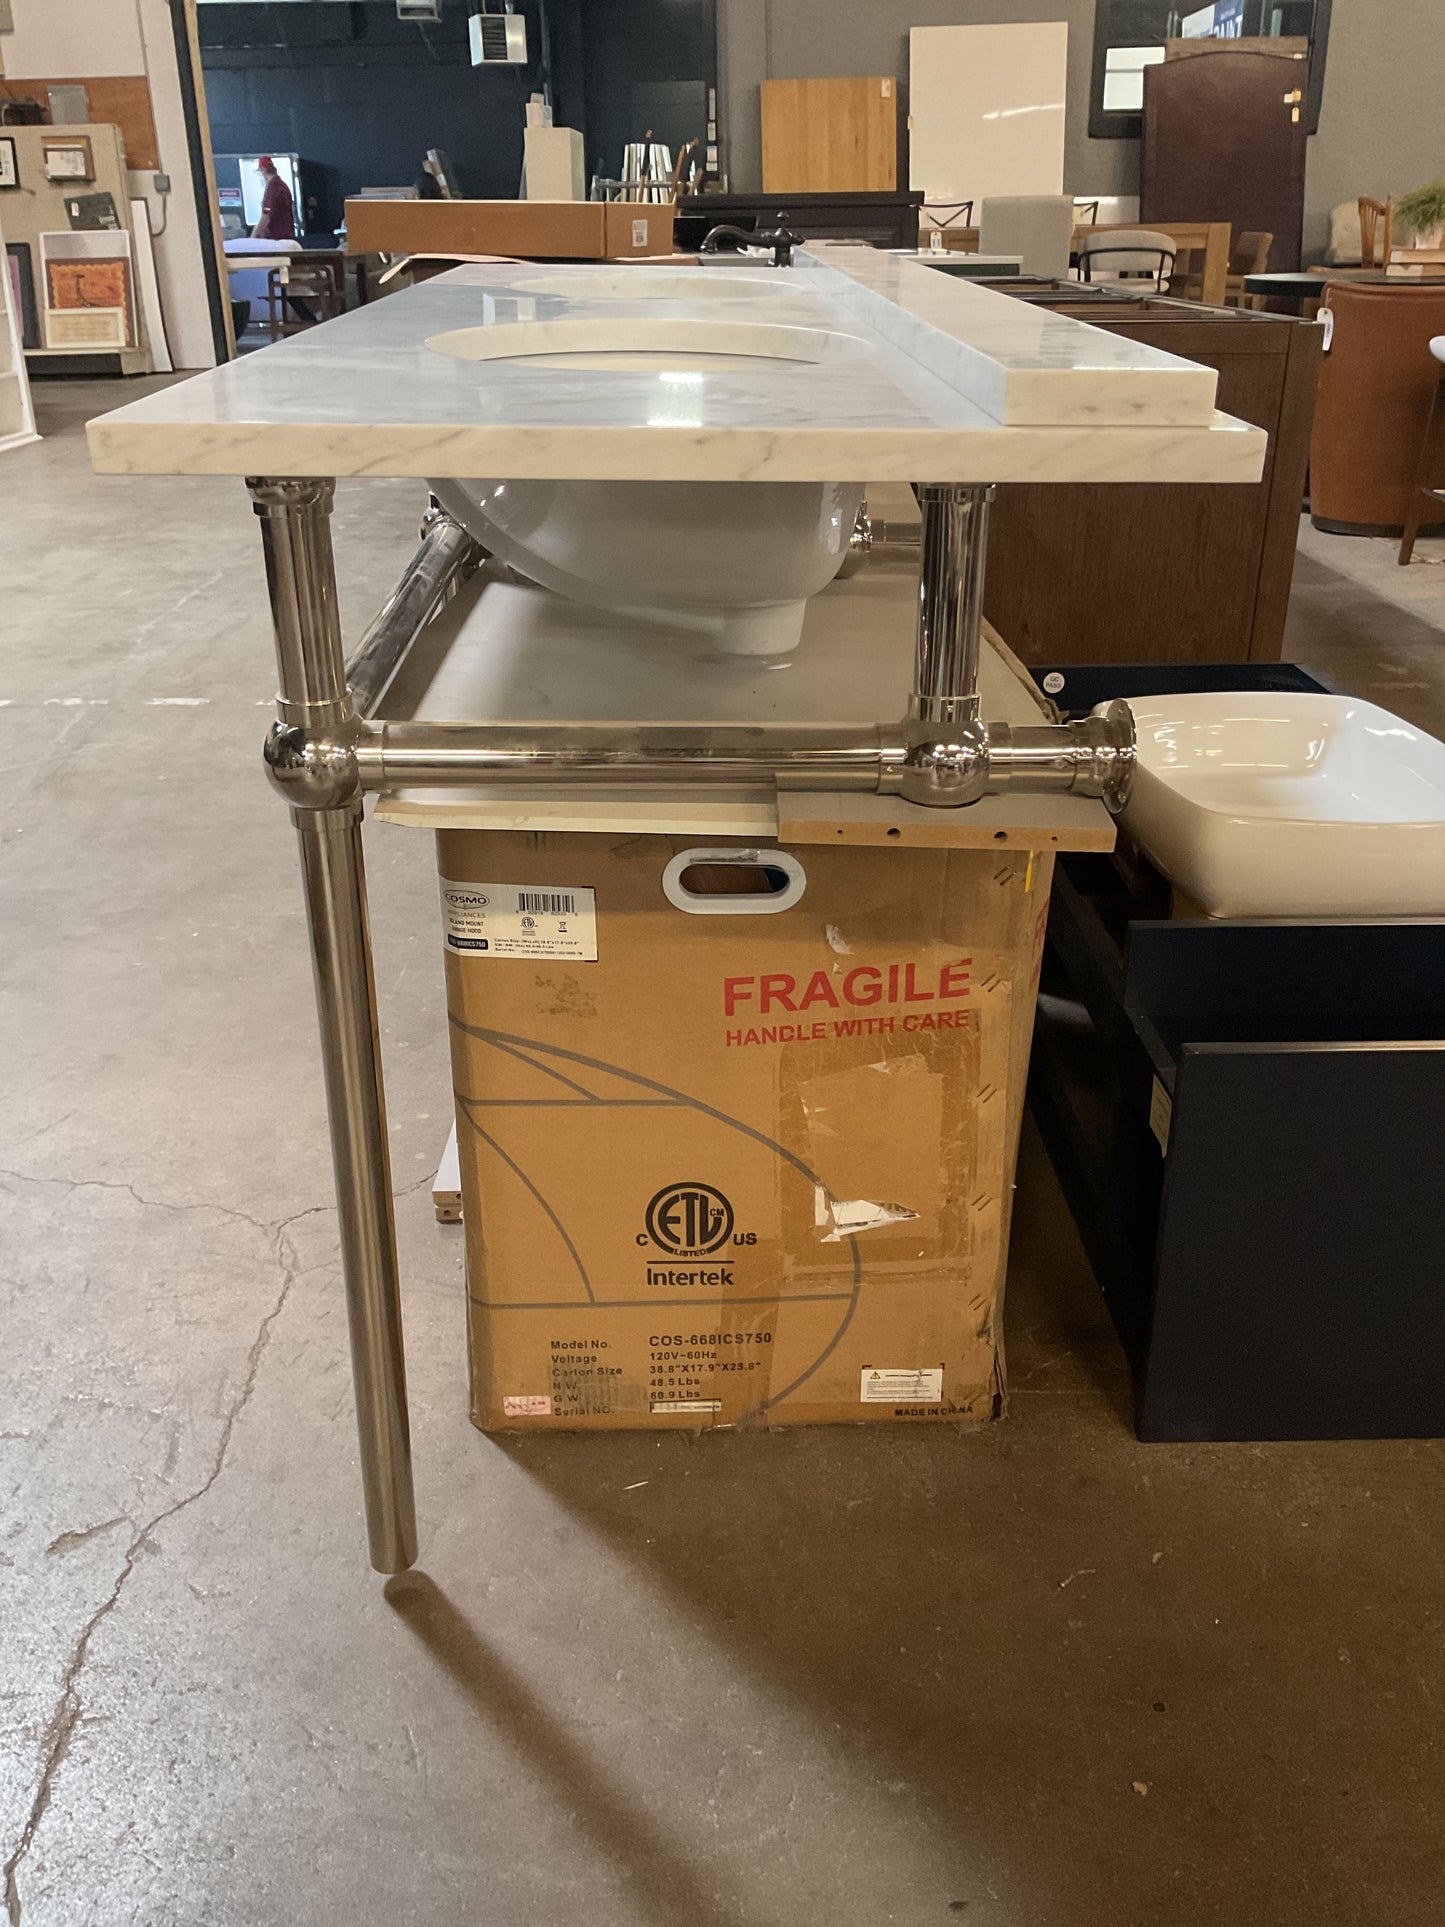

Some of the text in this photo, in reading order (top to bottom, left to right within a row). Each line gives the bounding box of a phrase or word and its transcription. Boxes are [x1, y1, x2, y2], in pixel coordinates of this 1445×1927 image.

[724, 957, 973, 1017] FRAGILE
[726, 1009, 970, 1047] HANDLE WITH CARE
[733, 1232, 757, 1246] US
[673, 1248, 707, 1256] LISTED
[647, 1268, 734, 1286] Intertek
[551, 1340, 612, 1350] Model No.
[649, 1332, 772, 1347] COS-668ICS750
[552, 1354, 598, 1364] Voltage
[552, 1366, 622, 1377] Carton Size
[650, 1377, 700, 1386] 48.5 Lbs
[650, 1390, 700, 1400] 60.9 Lbs
[554, 1406, 590, 1416] Serial
[894, 1405, 973, 1416] MADE IN CHNA
